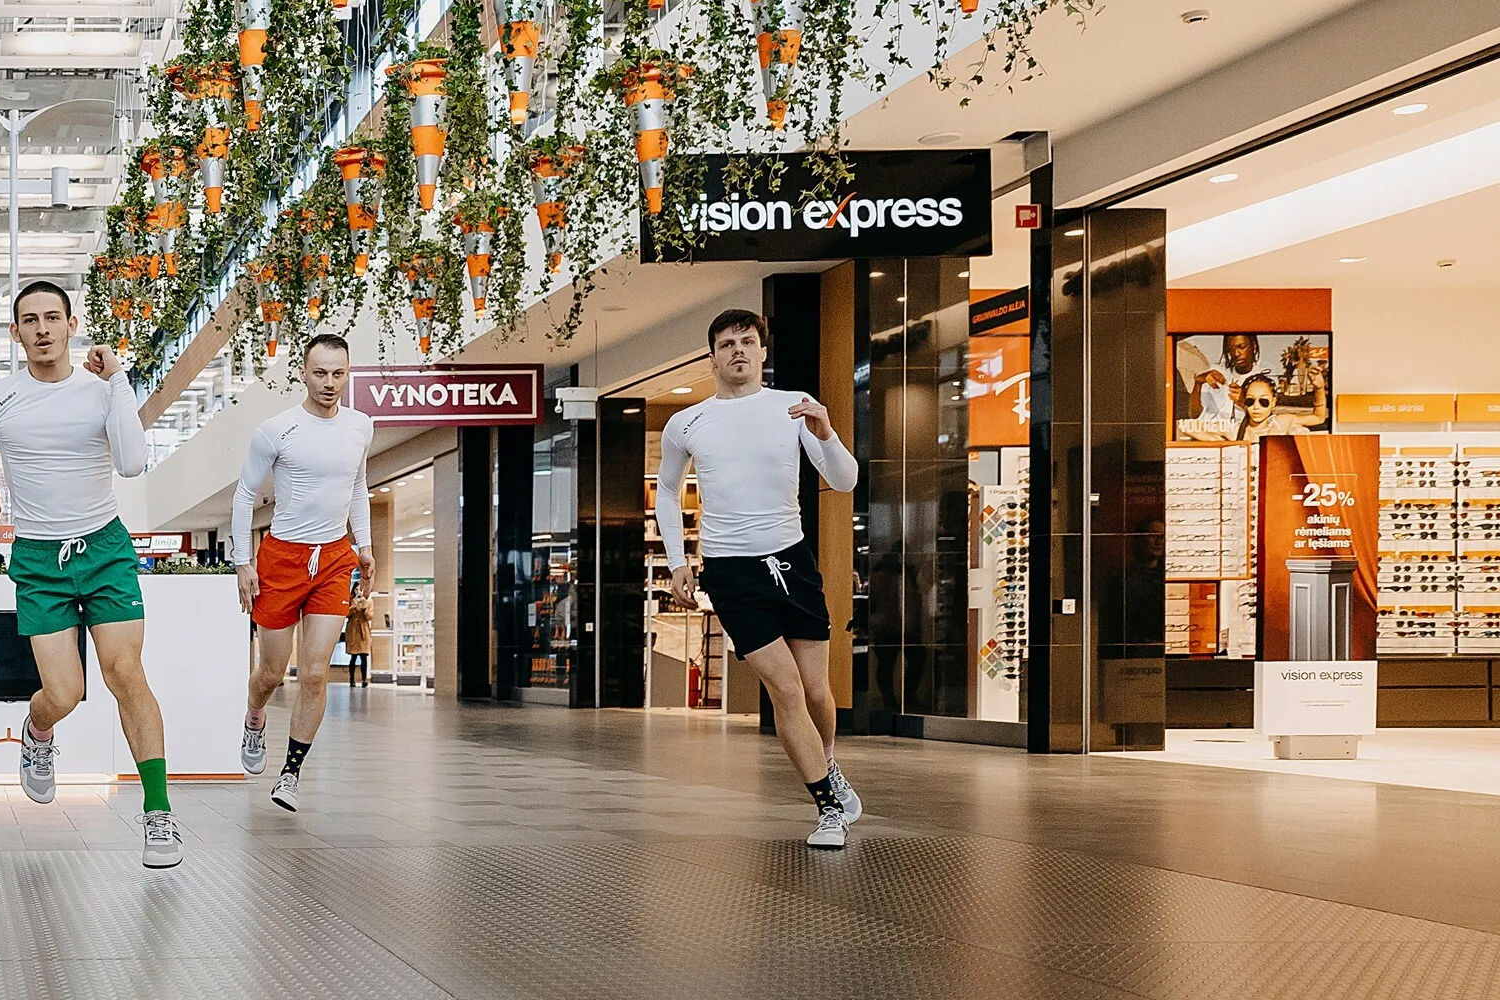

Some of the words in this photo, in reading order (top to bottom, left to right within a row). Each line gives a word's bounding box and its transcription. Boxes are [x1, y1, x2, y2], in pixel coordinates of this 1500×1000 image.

[676, 193, 792, 231] vision
[803, 192, 963, 238] express
[369, 383, 518, 407] VYNOTEKA
[1292, 483, 1355, 507] -25%
[1307, 514, 1340, 526] akinių
[1281, 670, 1316, 680] vision
[1320, 671, 1363, 682] express
